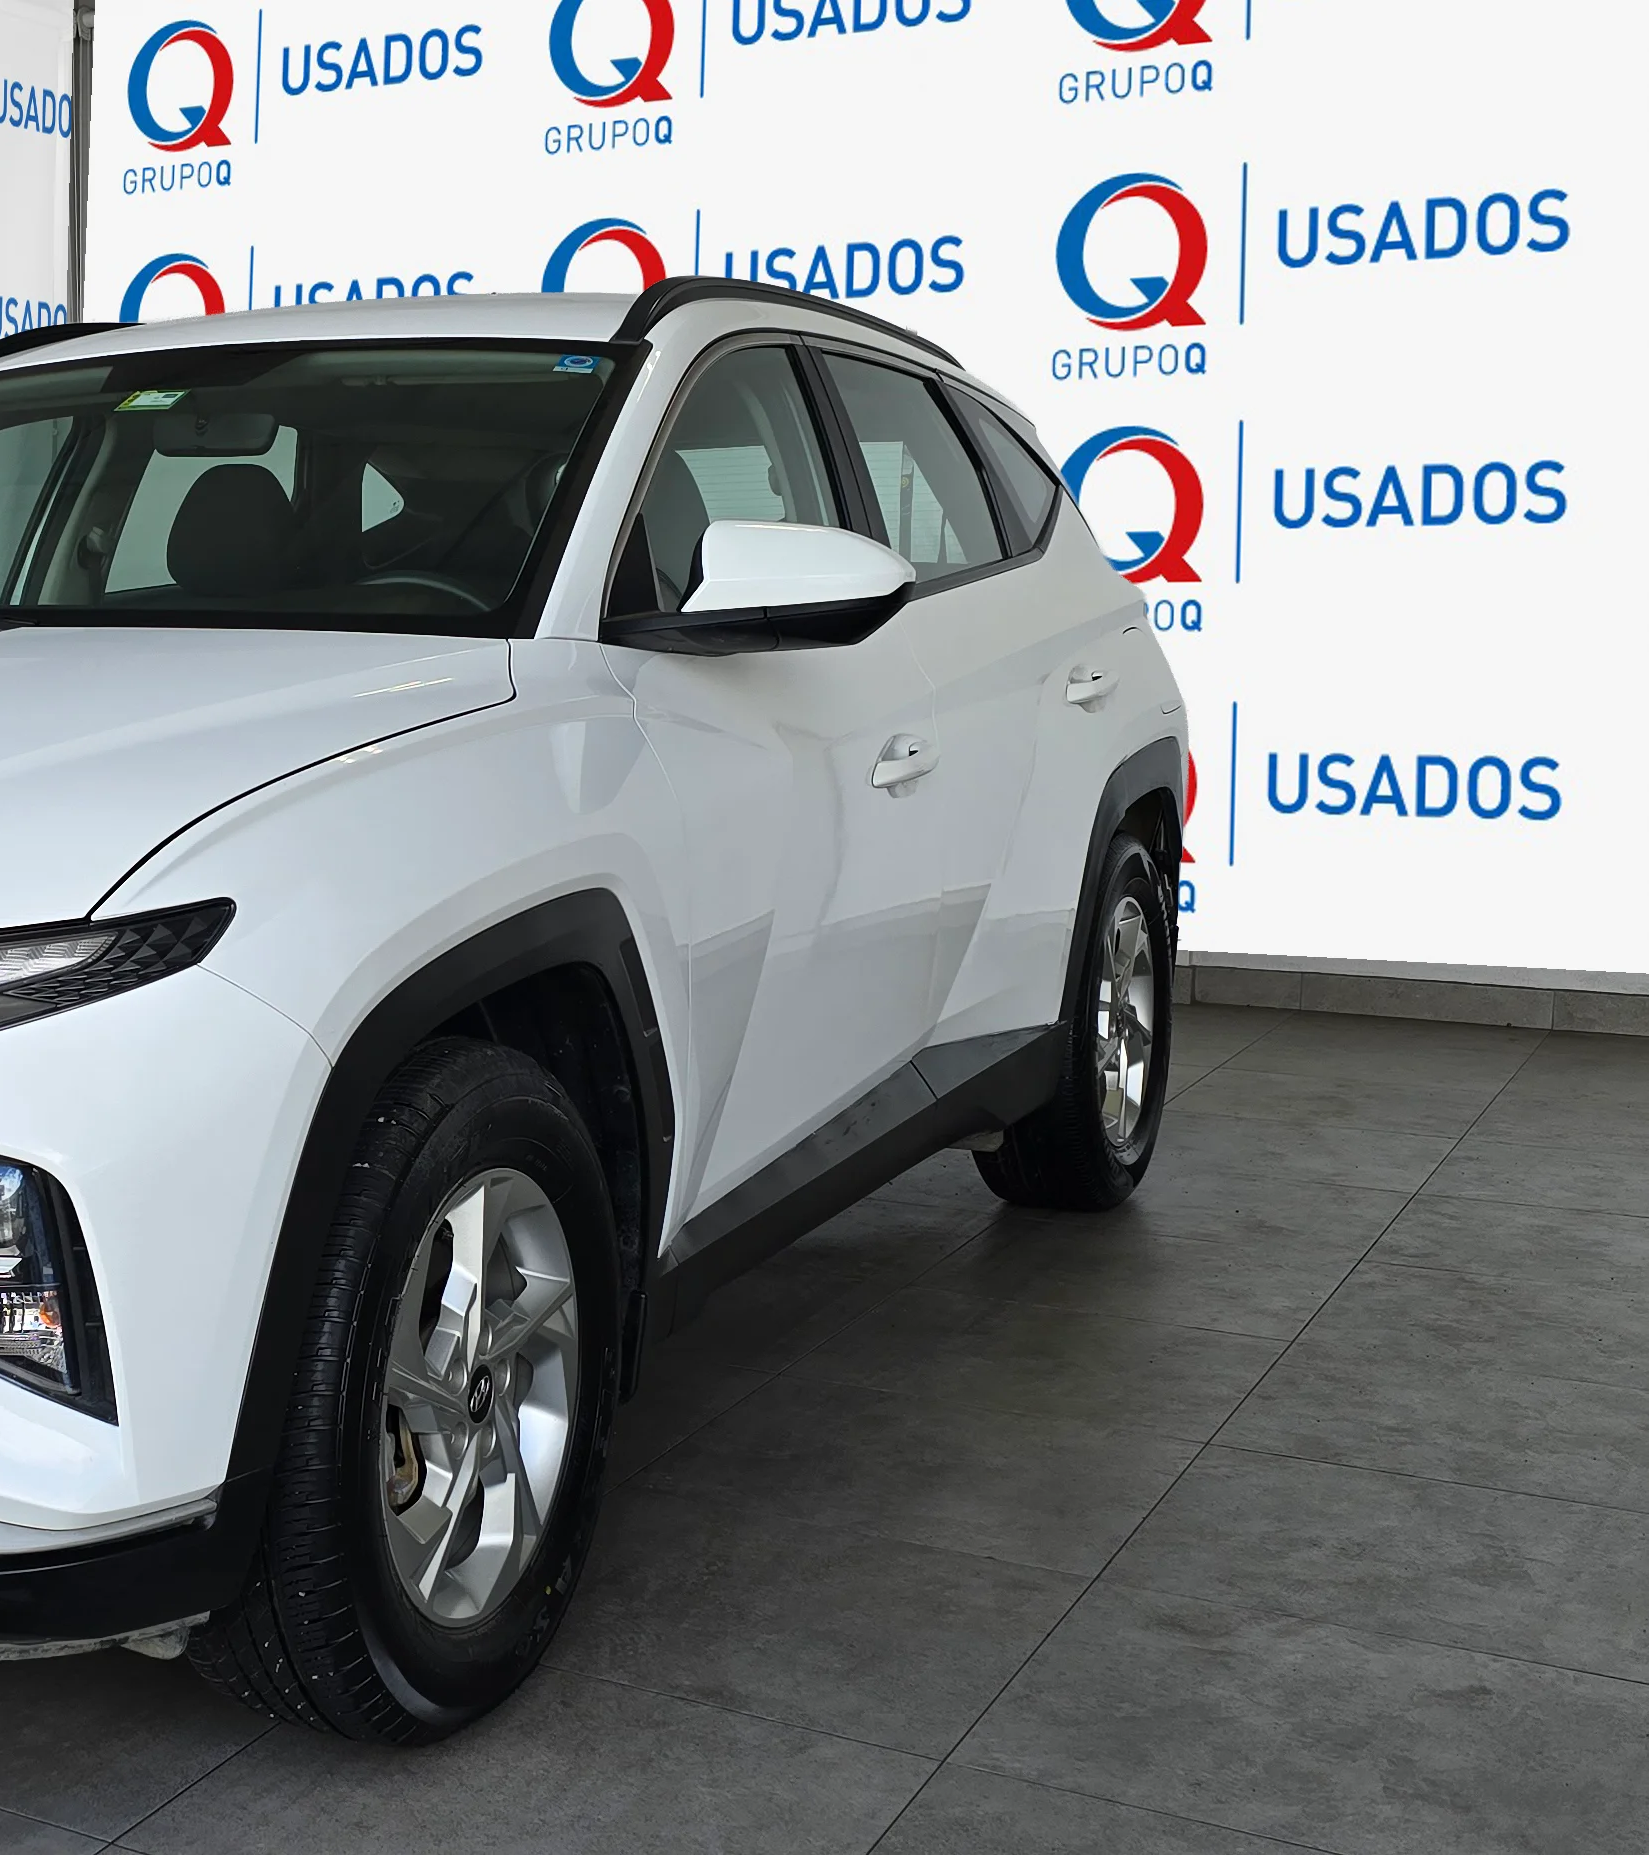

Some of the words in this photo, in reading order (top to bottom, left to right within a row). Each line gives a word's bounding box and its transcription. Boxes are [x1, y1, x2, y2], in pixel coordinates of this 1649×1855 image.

[281, 23, 484, 97] USADOS
[1058, 58, 1214, 105] GRUPOQ
[543, 114, 674, 156] GRUPOQ
[122, 158, 232, 196] GRUPOQ
[1276, 187, 1570, 270] USADOS
[1051, 341, 1207, 381] GRUPOQ
[1273, 459, 1568, 530] USADOS
[1266, 751, 1563, 822] USADOS
